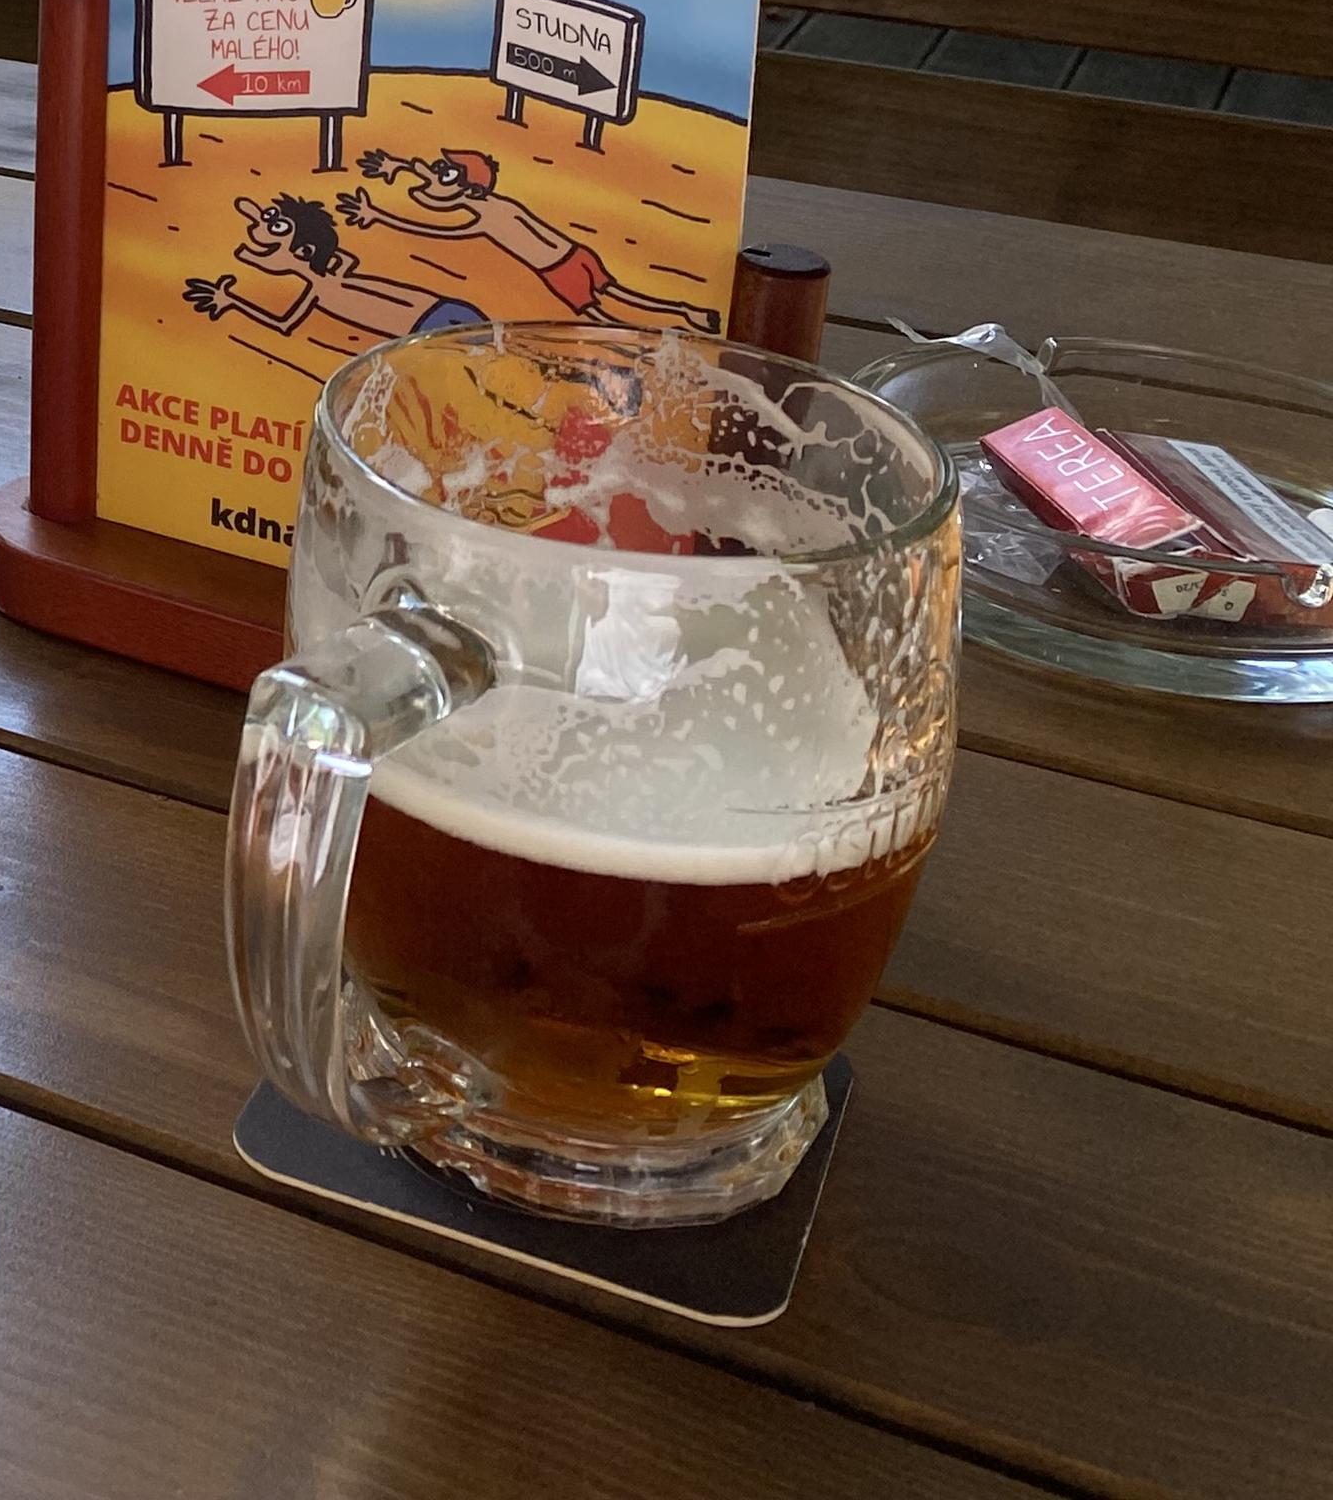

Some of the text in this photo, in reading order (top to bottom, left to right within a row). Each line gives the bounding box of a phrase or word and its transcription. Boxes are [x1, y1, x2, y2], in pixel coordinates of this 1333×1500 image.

[203, 7, 310, 32] ZA CENU
[515, 7, 612, 55] STUDNA
[210, 34, 301, 60] MALÉHO!
[513, 46, 578, 83] 500 m
[240, 74, 302, 95] 10 km
[115, 383, 307, 453] AKCE PLATÍ
[120, 417, 293, 484] DENNĚ DO
[1021, 415, 1143, 512] TEREA
